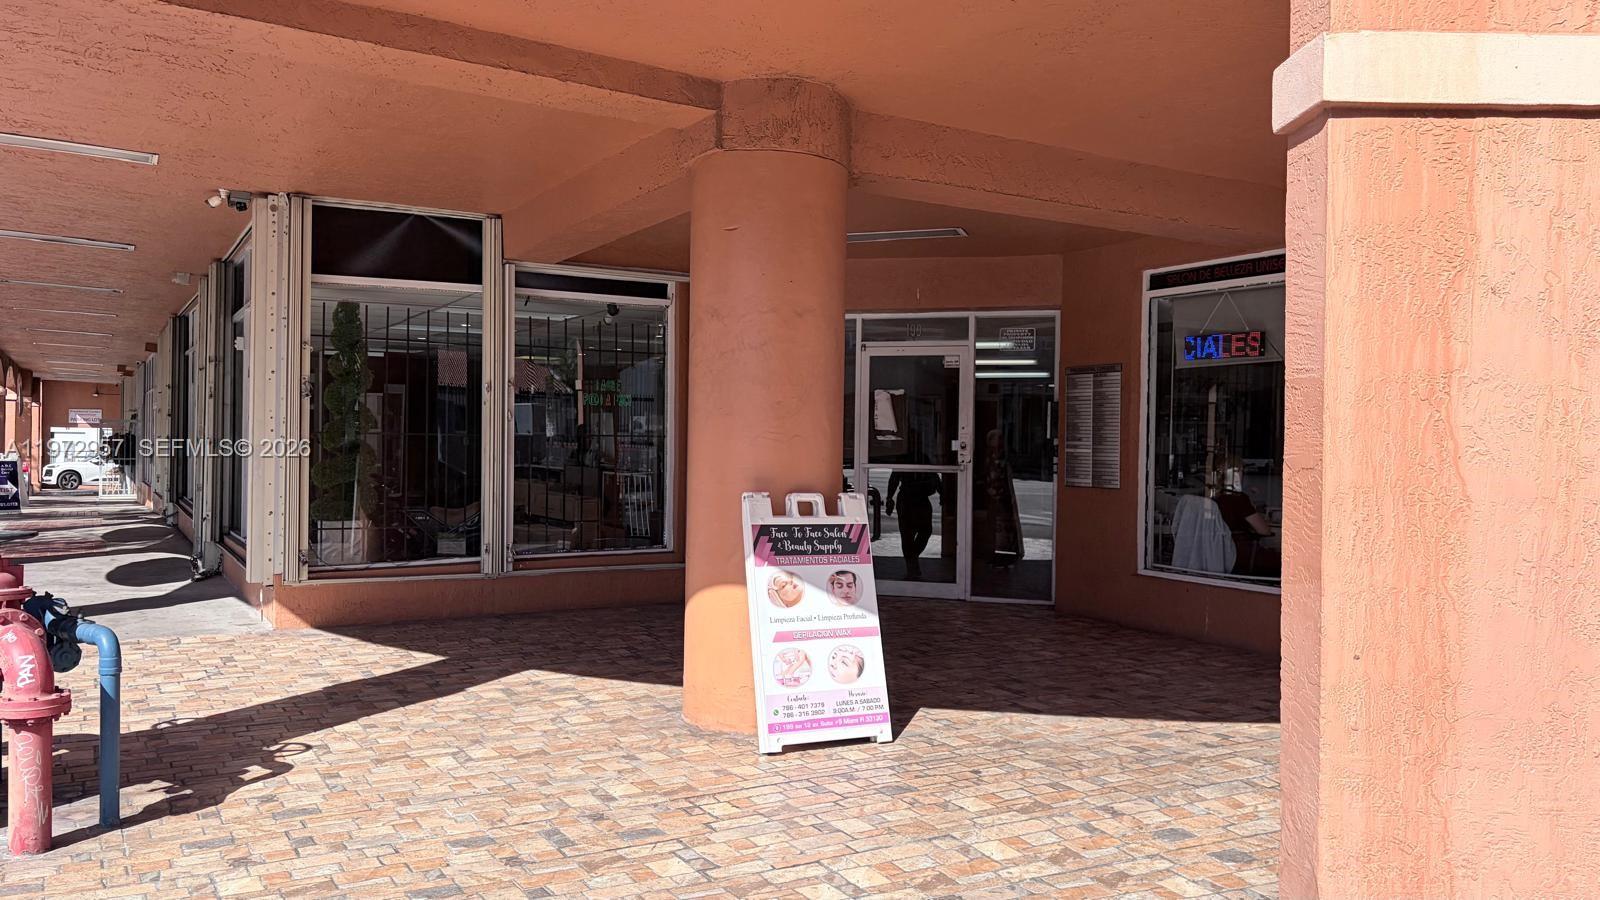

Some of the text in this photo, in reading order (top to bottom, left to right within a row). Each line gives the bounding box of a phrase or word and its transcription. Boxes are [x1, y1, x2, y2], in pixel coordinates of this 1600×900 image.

[1167, 257, 1285, 284] SALON DE BELLEZA UNISE
[769, 526, 848, 539] Face To Face Salon
[782, 539, 812, 555] Beauty
[813, 539, 843, 554] Supply
[775, 555, 860, 565] TRATAMIENTOS FACIALES
[769, 616, 796, 624] Limpieza
[817, 614, 843, 622] Limpieza
[843, 612, 867, 620] Profunda
[835, 628, 853, 637] WAX
[859, 697, 881, 705] SABADO
